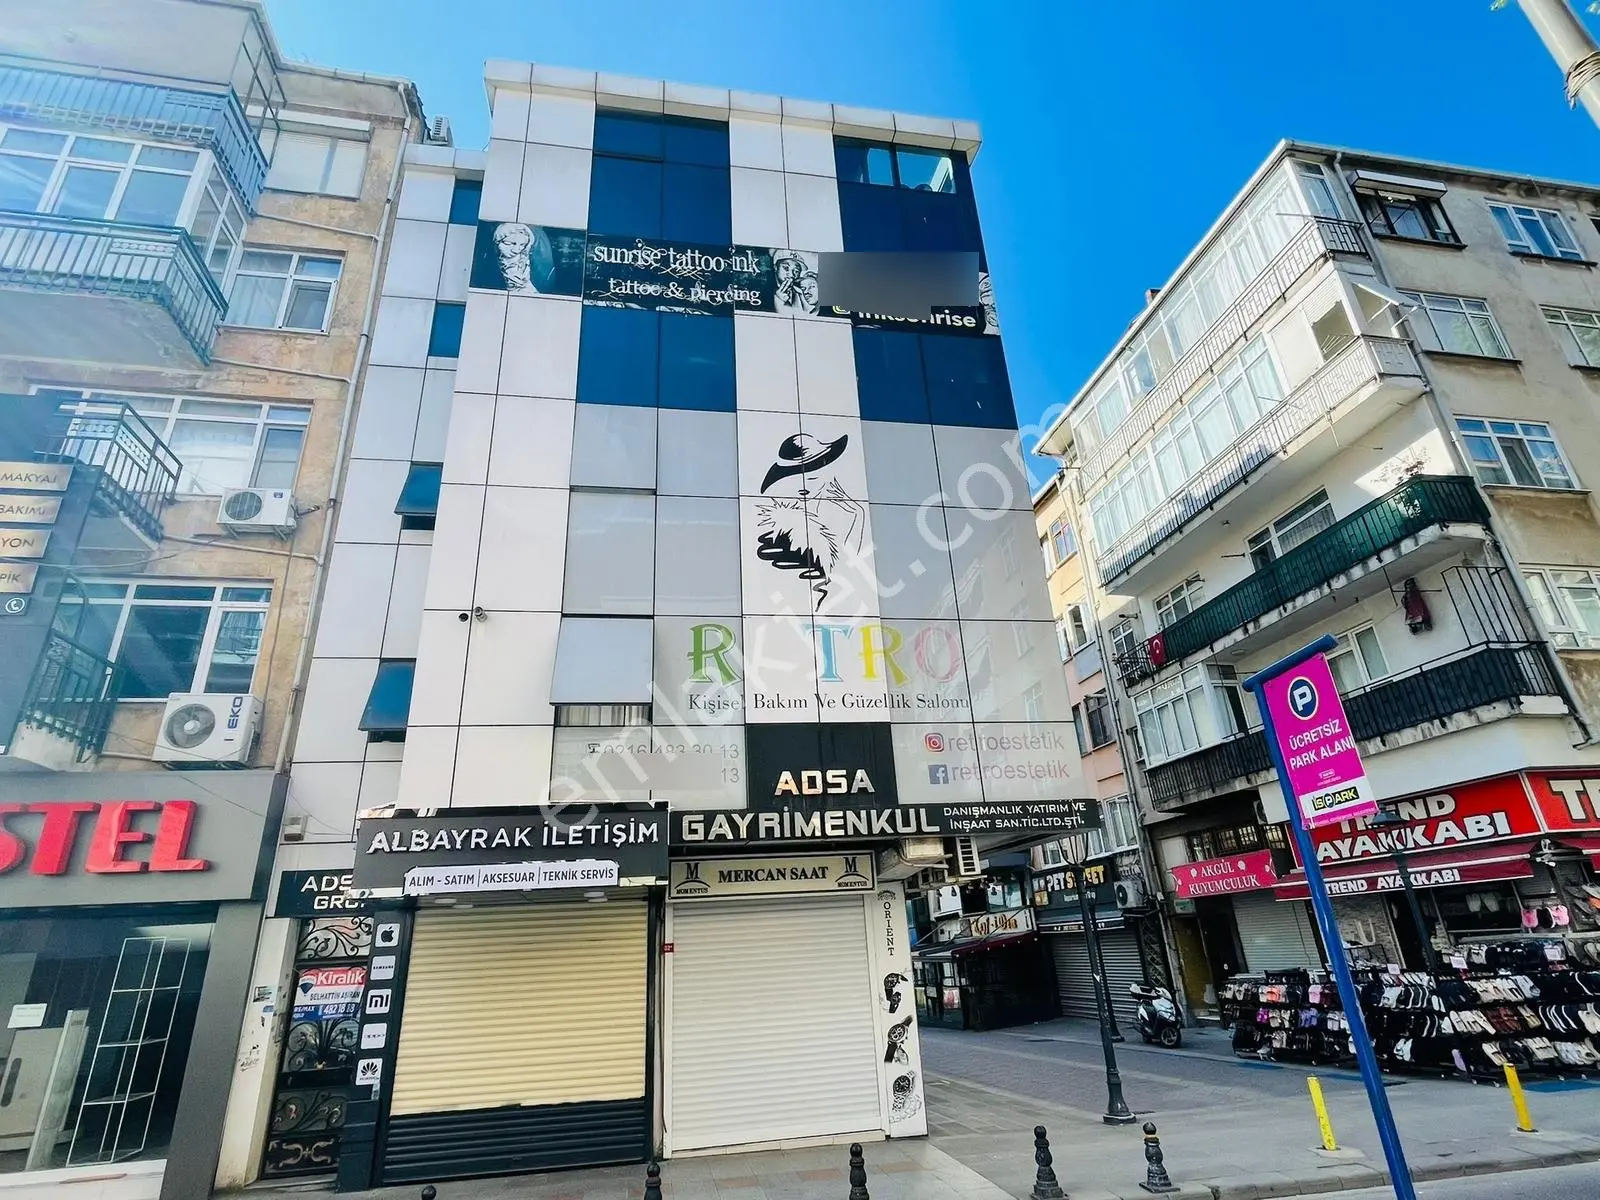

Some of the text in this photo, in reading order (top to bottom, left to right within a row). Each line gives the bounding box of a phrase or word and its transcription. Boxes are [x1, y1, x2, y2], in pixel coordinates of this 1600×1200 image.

[594, 240, 761, 275] sunrise tattoo ink
[608, 277, 663, 297] tattoo
[690, 283, 762, 305] piercing
[753, 692, 808, 710] Bakım
[815, 692, 836, 709] Ve
[841, 691, 912, 710] Güzellik
[916, 692, 970, 710] Salonu
[948, 732, 1065, 751] retroestetik
[1288, 718, 1343, 751] ÜCRETSİZ
[1289, 735, 1356, 770] PARK ALANI
[951, 760, 1070, 781] retroestetik
[775, 769, 875, 796] ADSA
[943, 802, 1087, 819] DANIŞMANLIK YATIRIM VE
[682, 806, 941, 842] GAYRİMENKUL
[366, 817, 660, 855] ALBAYRAK İLETİŞİM
[1316, 811, 1512, 862] AYAKKABI
[482, 871, 536, 885] AKSESUAR
[543, 866, 614, 882] TEKNİK SERVİS
[718, 866, 830, 884] MERCAN SAAT
[1200, 859, 1235, 878] AKGÜL
[409, 875, 435, 887] ALIM
[444, 874, 475, 886] SATIM
[1046, 872, 1065, 892] PET
[1189, 875, 1261, 896] KUYUMCULUK
[1326, 878, 1369, 895] TREND
[883, 901, 895, 956] ORIENT
